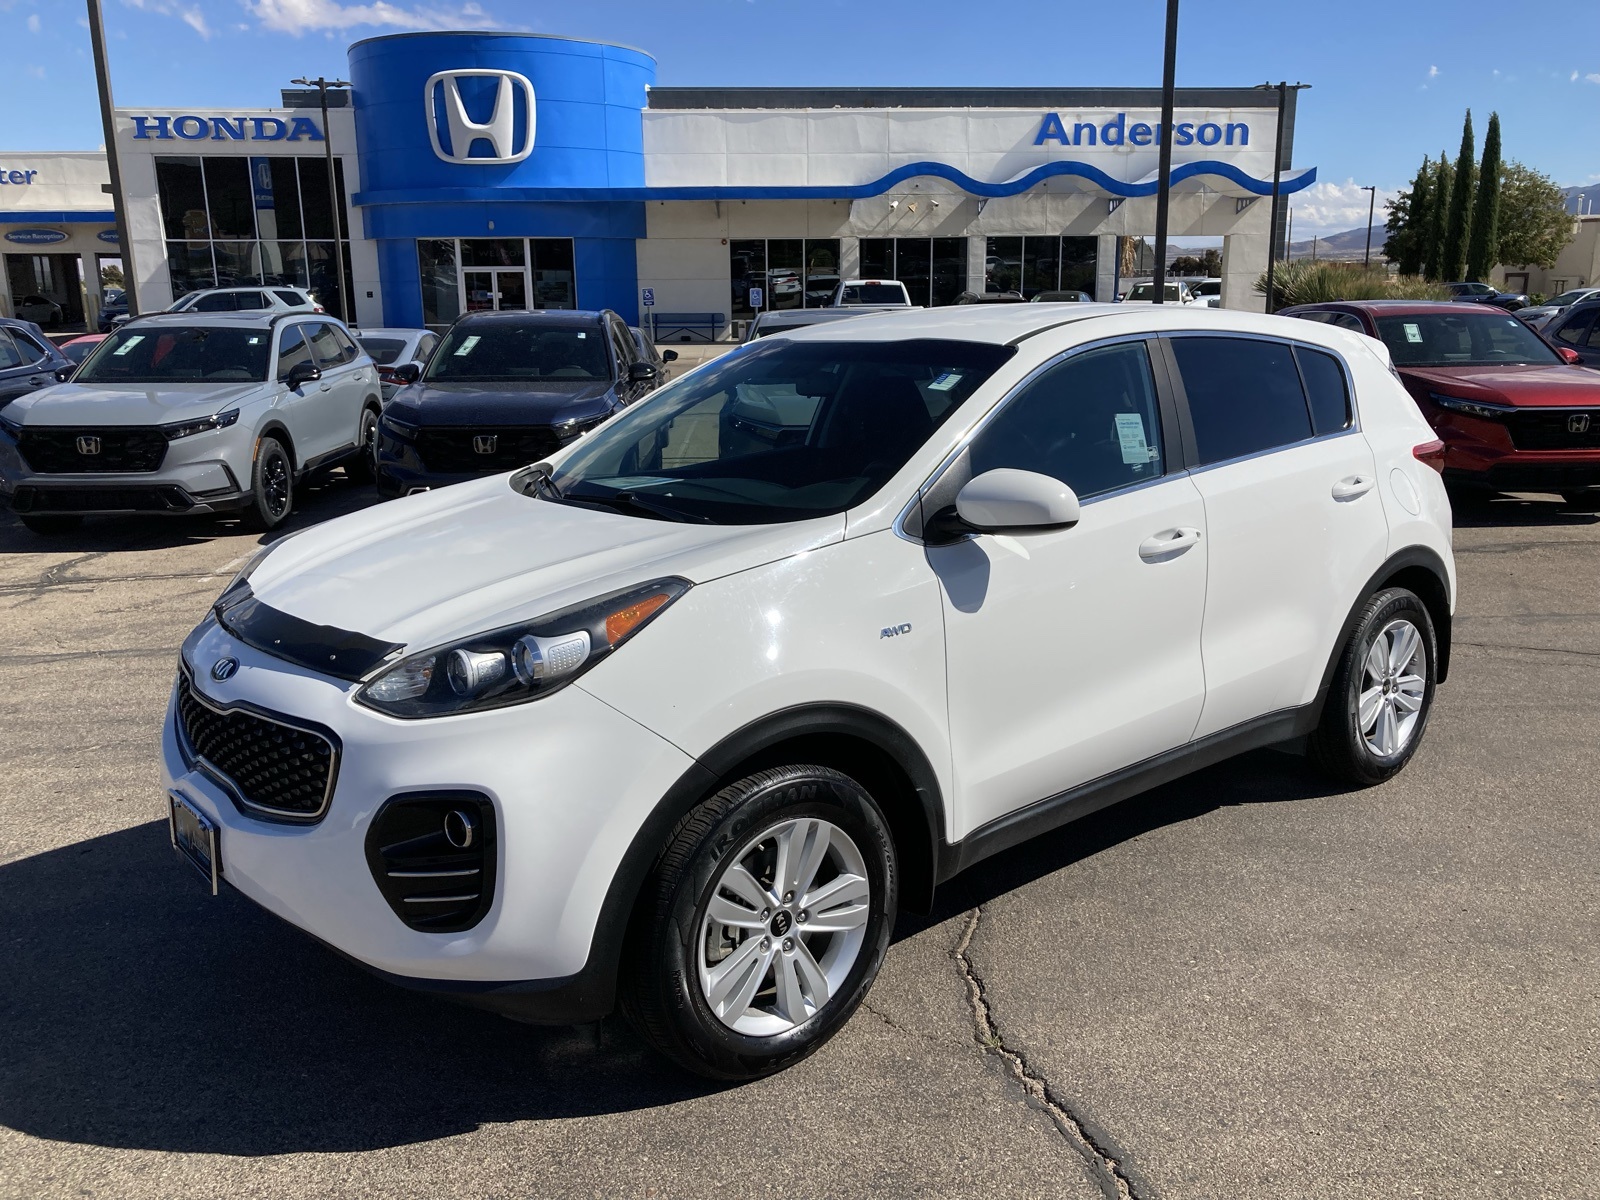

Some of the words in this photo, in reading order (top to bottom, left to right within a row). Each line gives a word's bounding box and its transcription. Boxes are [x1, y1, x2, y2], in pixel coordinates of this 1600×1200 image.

[130, 116, 325, 141] HONDA
[0, 167, 38, 185] ter
[880, 622, 912, 640] AWD
[775, 912, 788, 935] KIA
